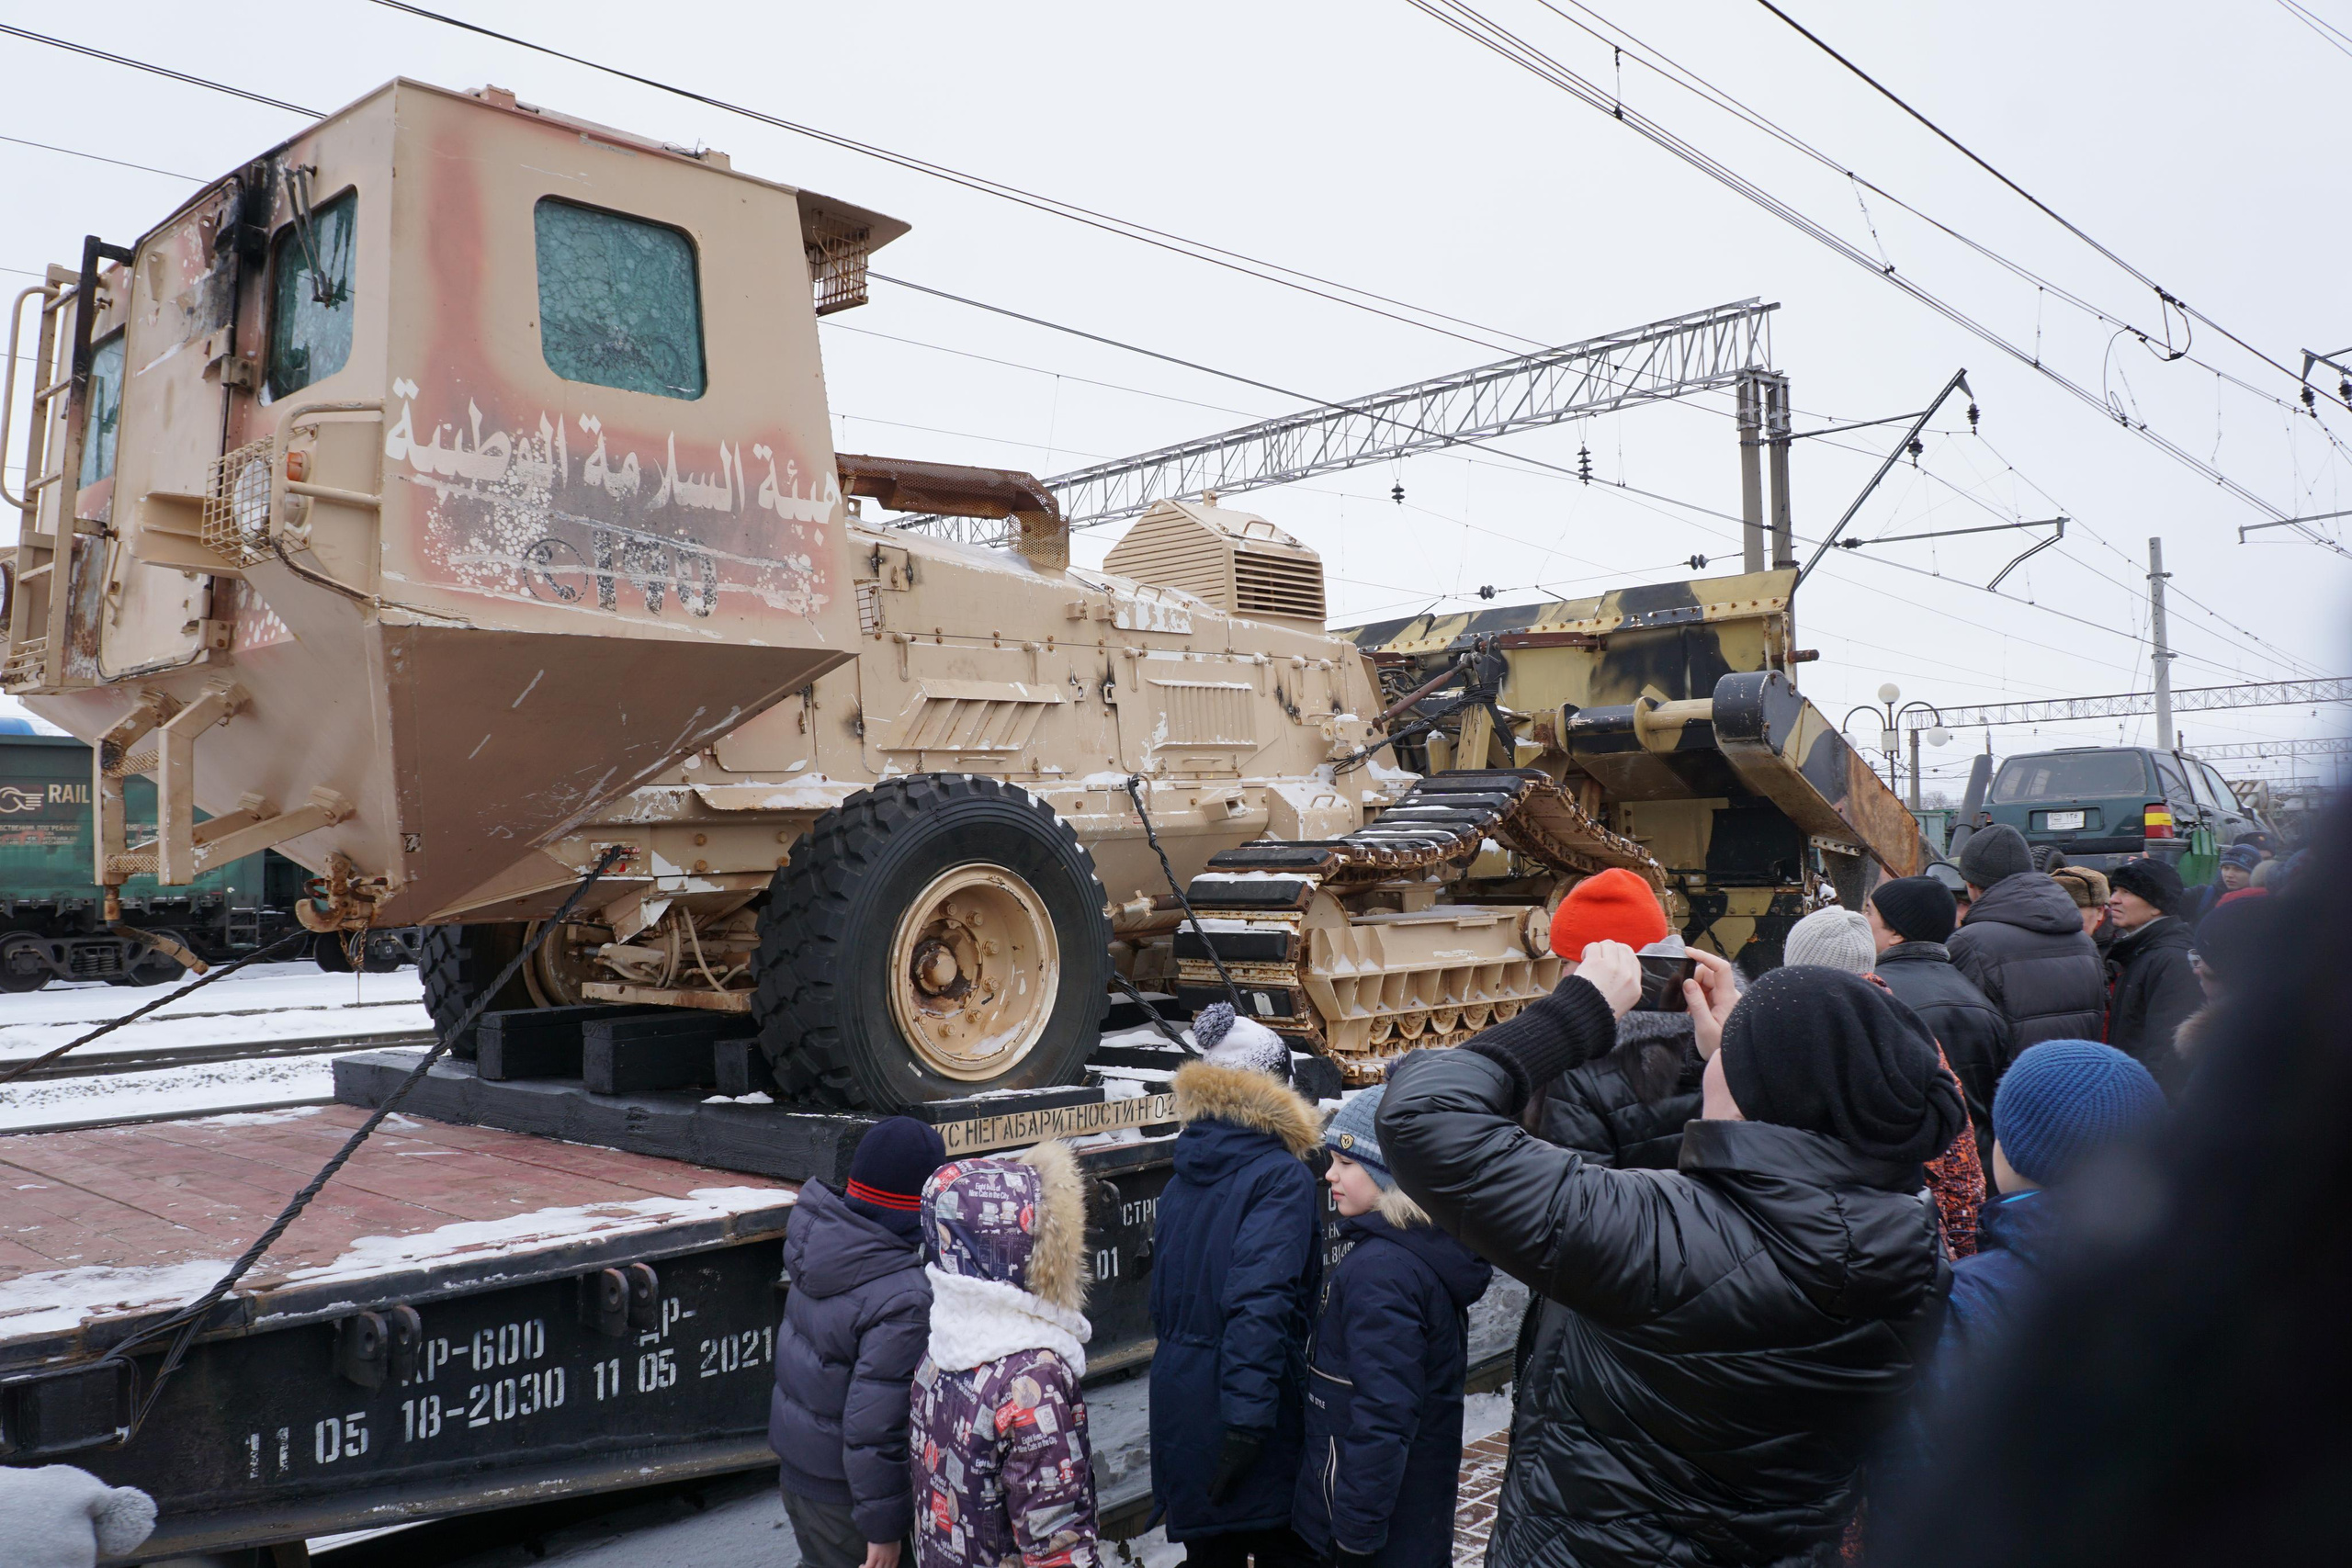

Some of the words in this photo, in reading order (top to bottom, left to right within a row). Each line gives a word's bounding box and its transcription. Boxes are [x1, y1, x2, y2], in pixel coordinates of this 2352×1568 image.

[578, 412, 745, 513] السلامة
[48, 784, 90, 804] RAIL
[401, 1318, 545, 1387] Р-600
[594, 1358, 620, 1402] 11
[638, 1348, 676, 1393] 05
[700, 1325, 772, 1379] 2021
[315, 1411, 368, 1464] 05
[401, 1366, 566, 1443] 18-2030
